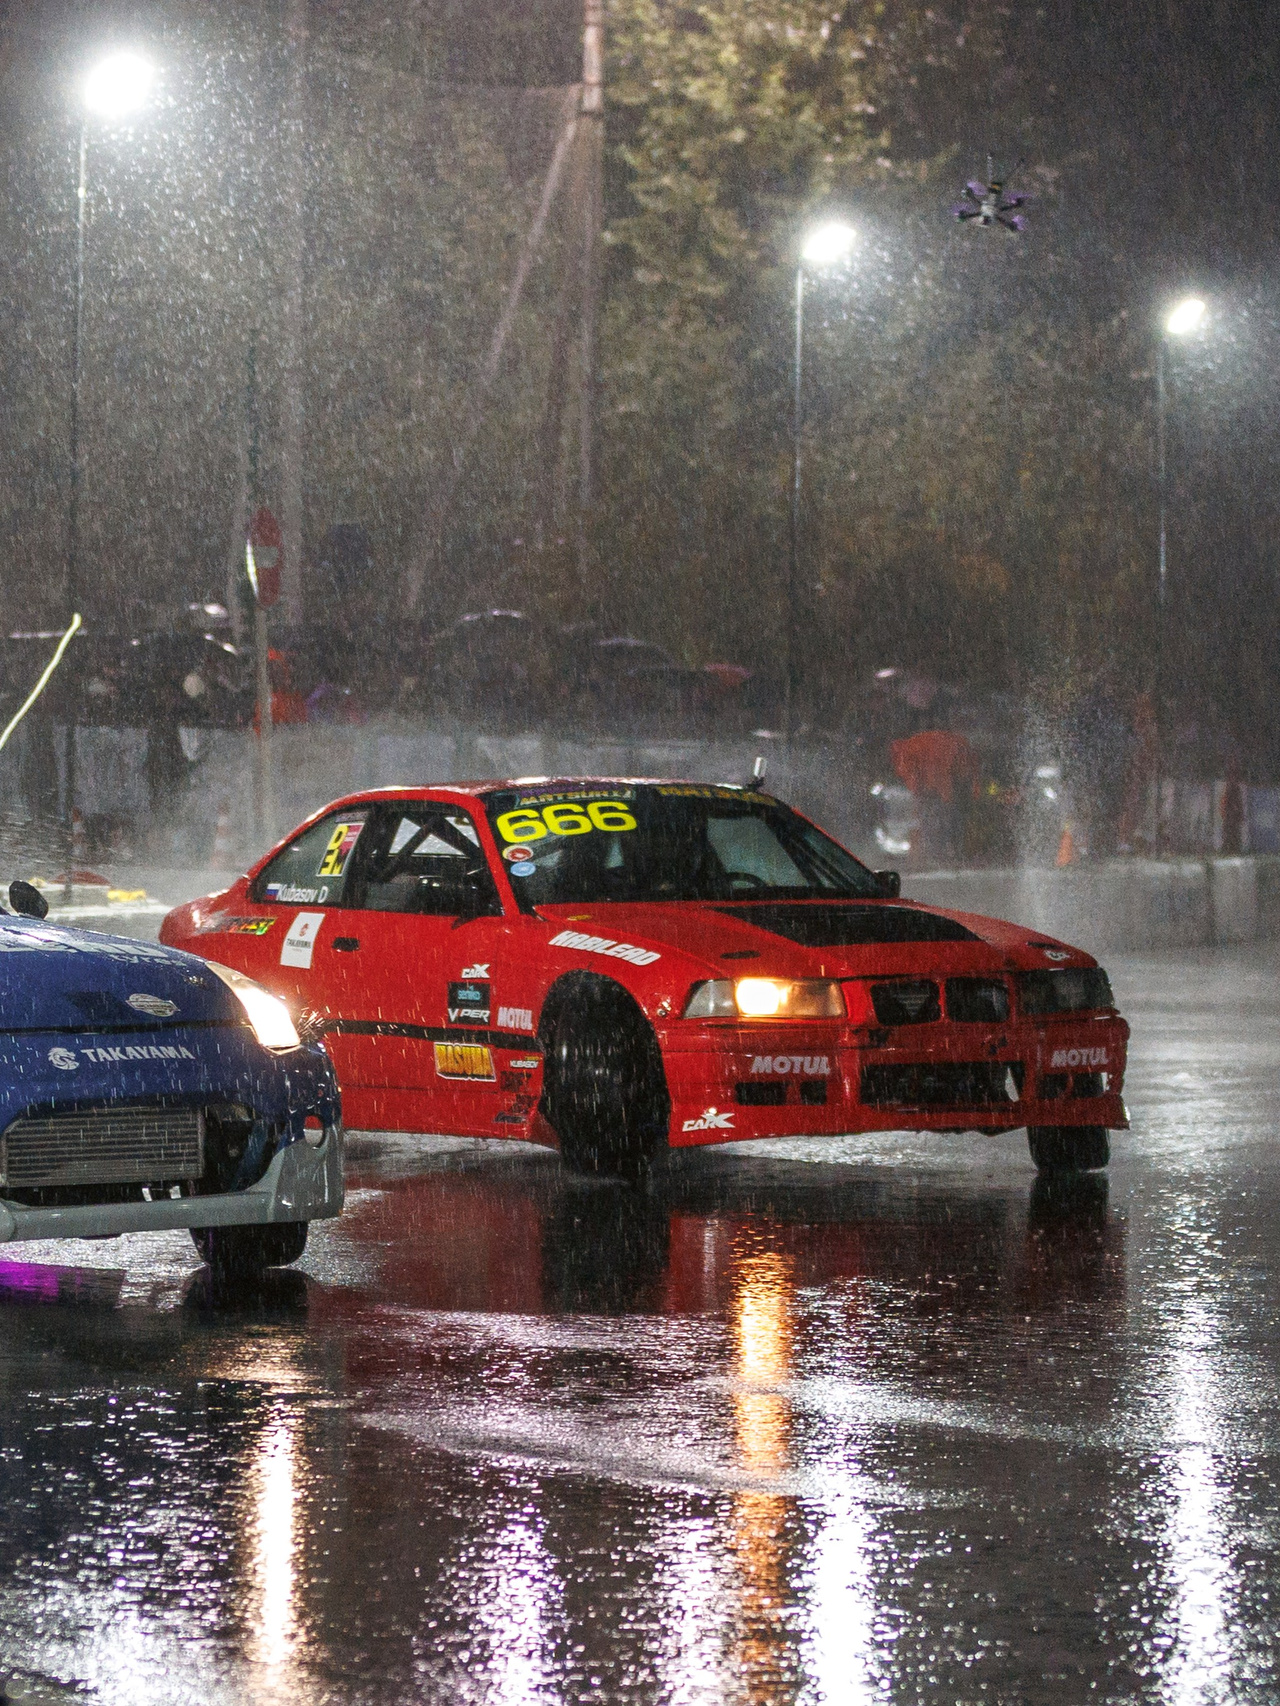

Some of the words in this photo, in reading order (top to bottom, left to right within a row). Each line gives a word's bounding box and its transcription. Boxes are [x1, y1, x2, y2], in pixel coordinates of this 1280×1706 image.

[496, 801, 638, 843] 666
[276, 882, 318, 903] Kubasov
[318, 886, 329, 903] D
[548, 930, 662, 966] HABILEAD
[448, 1008, 491, 1023] VIPER
[497, 1006, 533, 1031] MOTUL
[80, 1046, 196, 1063] TAKAYAMA
[435, 1043, 495, 1080] MASUMA
[750, 1055, 832, 1075] MOTUL
[1051, 1046, 1109, 1068] MOTUL
